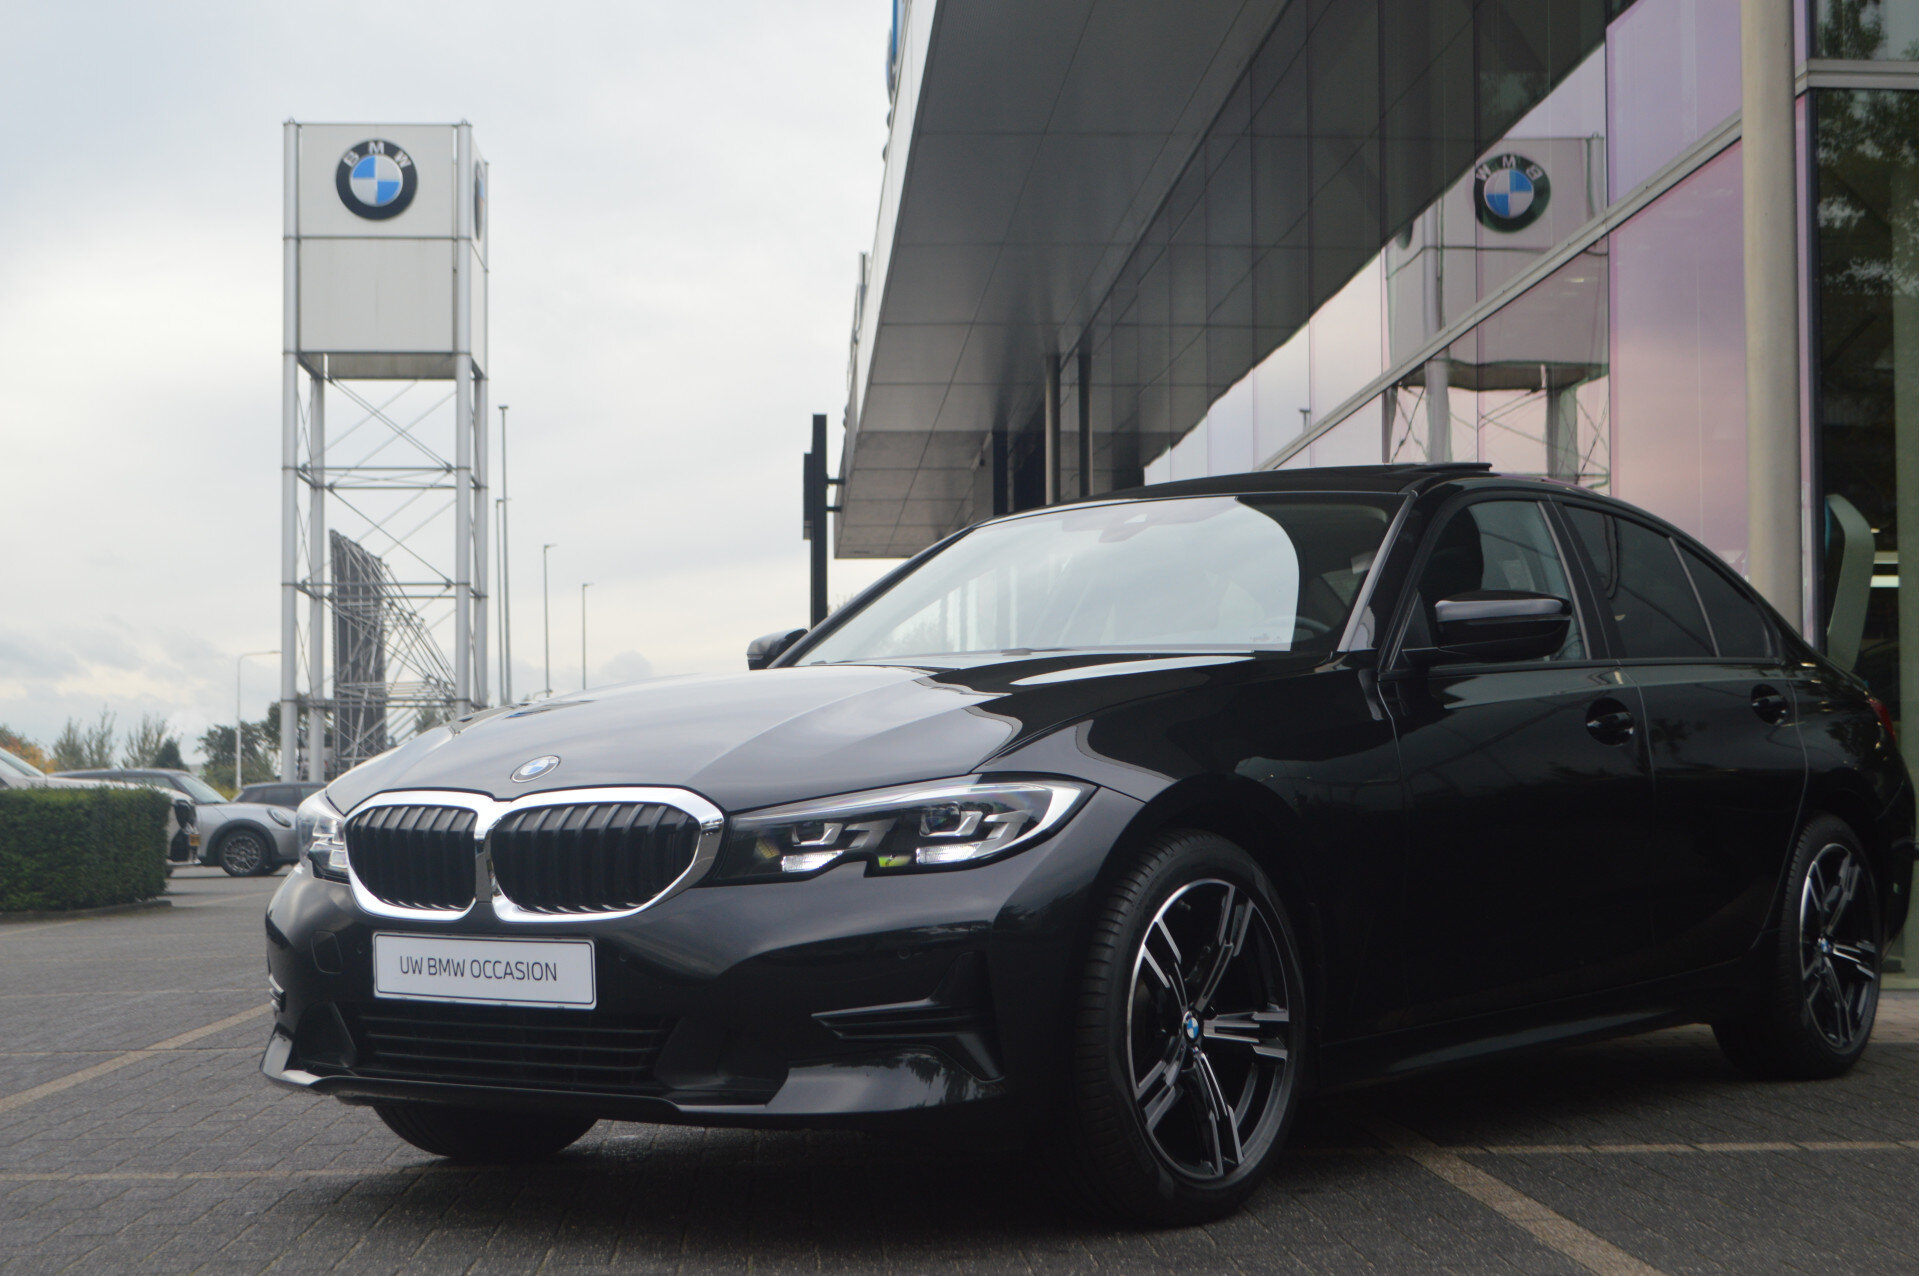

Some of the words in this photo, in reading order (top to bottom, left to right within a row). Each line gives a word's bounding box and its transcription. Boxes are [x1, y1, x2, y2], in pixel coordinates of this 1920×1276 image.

[343, 141, 412, 168] BMW
[400, 956, 423, 975] UW
[427, 957, 466, 978] BMW
[470, 959, 558, 981] OCCASION
